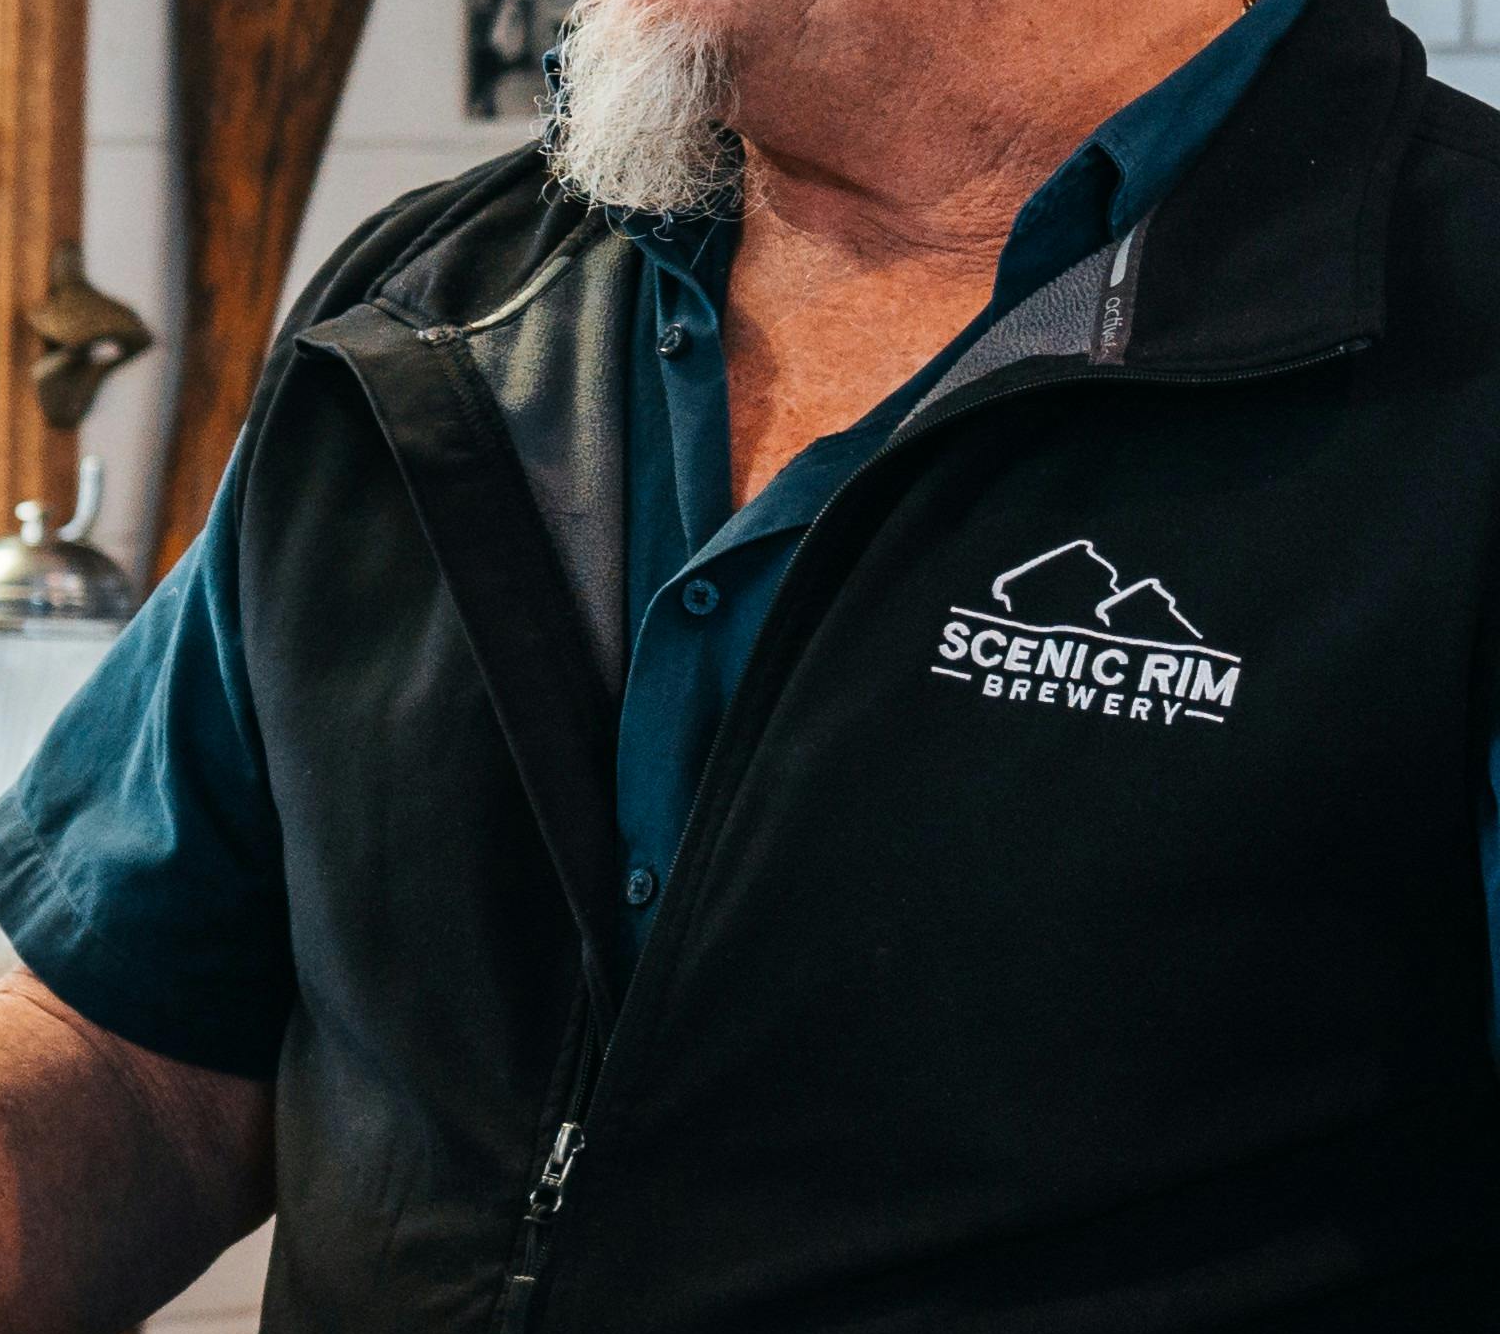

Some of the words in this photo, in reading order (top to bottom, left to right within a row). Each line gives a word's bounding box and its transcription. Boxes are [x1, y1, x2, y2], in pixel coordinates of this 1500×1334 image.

[938, 621, 1129, 686] SCENIC
[1138, 653, 1241, 707] RIM
[982, 673, 1182, 725] BREWERY
